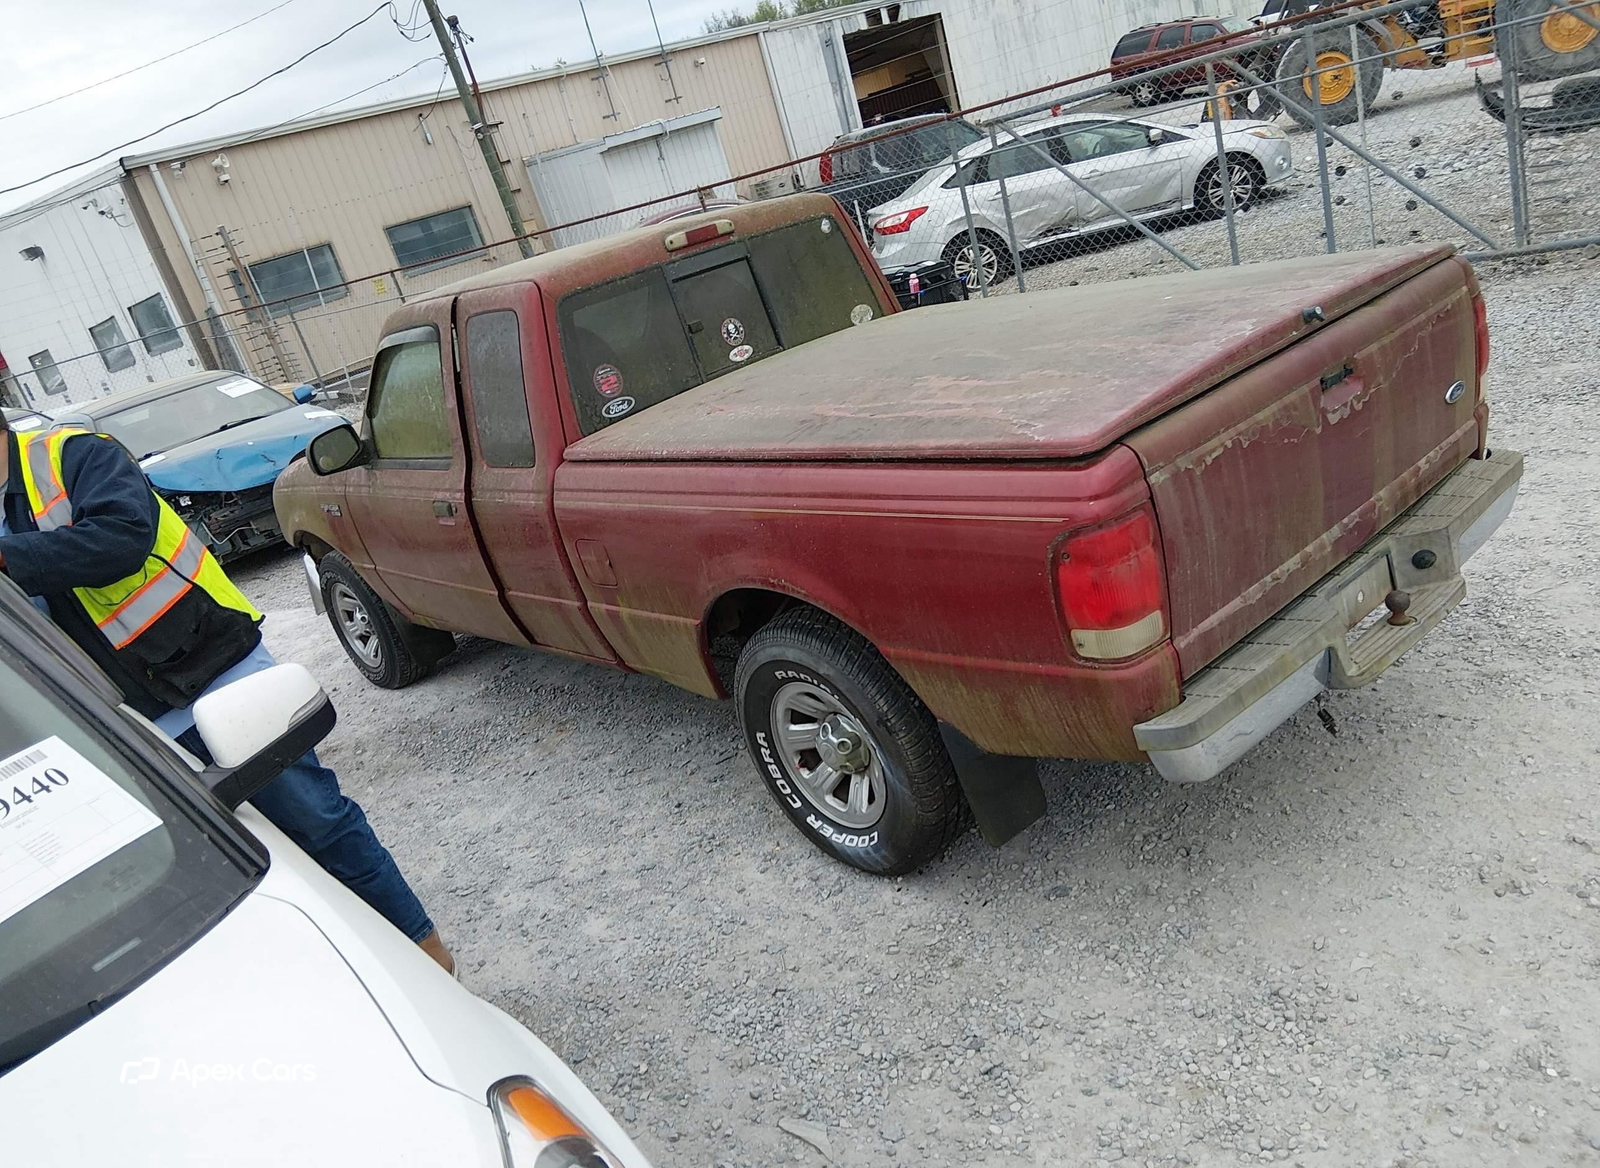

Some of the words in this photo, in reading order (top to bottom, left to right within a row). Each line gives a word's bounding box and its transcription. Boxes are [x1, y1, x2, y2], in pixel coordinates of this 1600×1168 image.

[774, 670, 840, 700] RADIA
[755, 731, 803, 809] COBRA
[806, 813, 880, 849] COOPER
